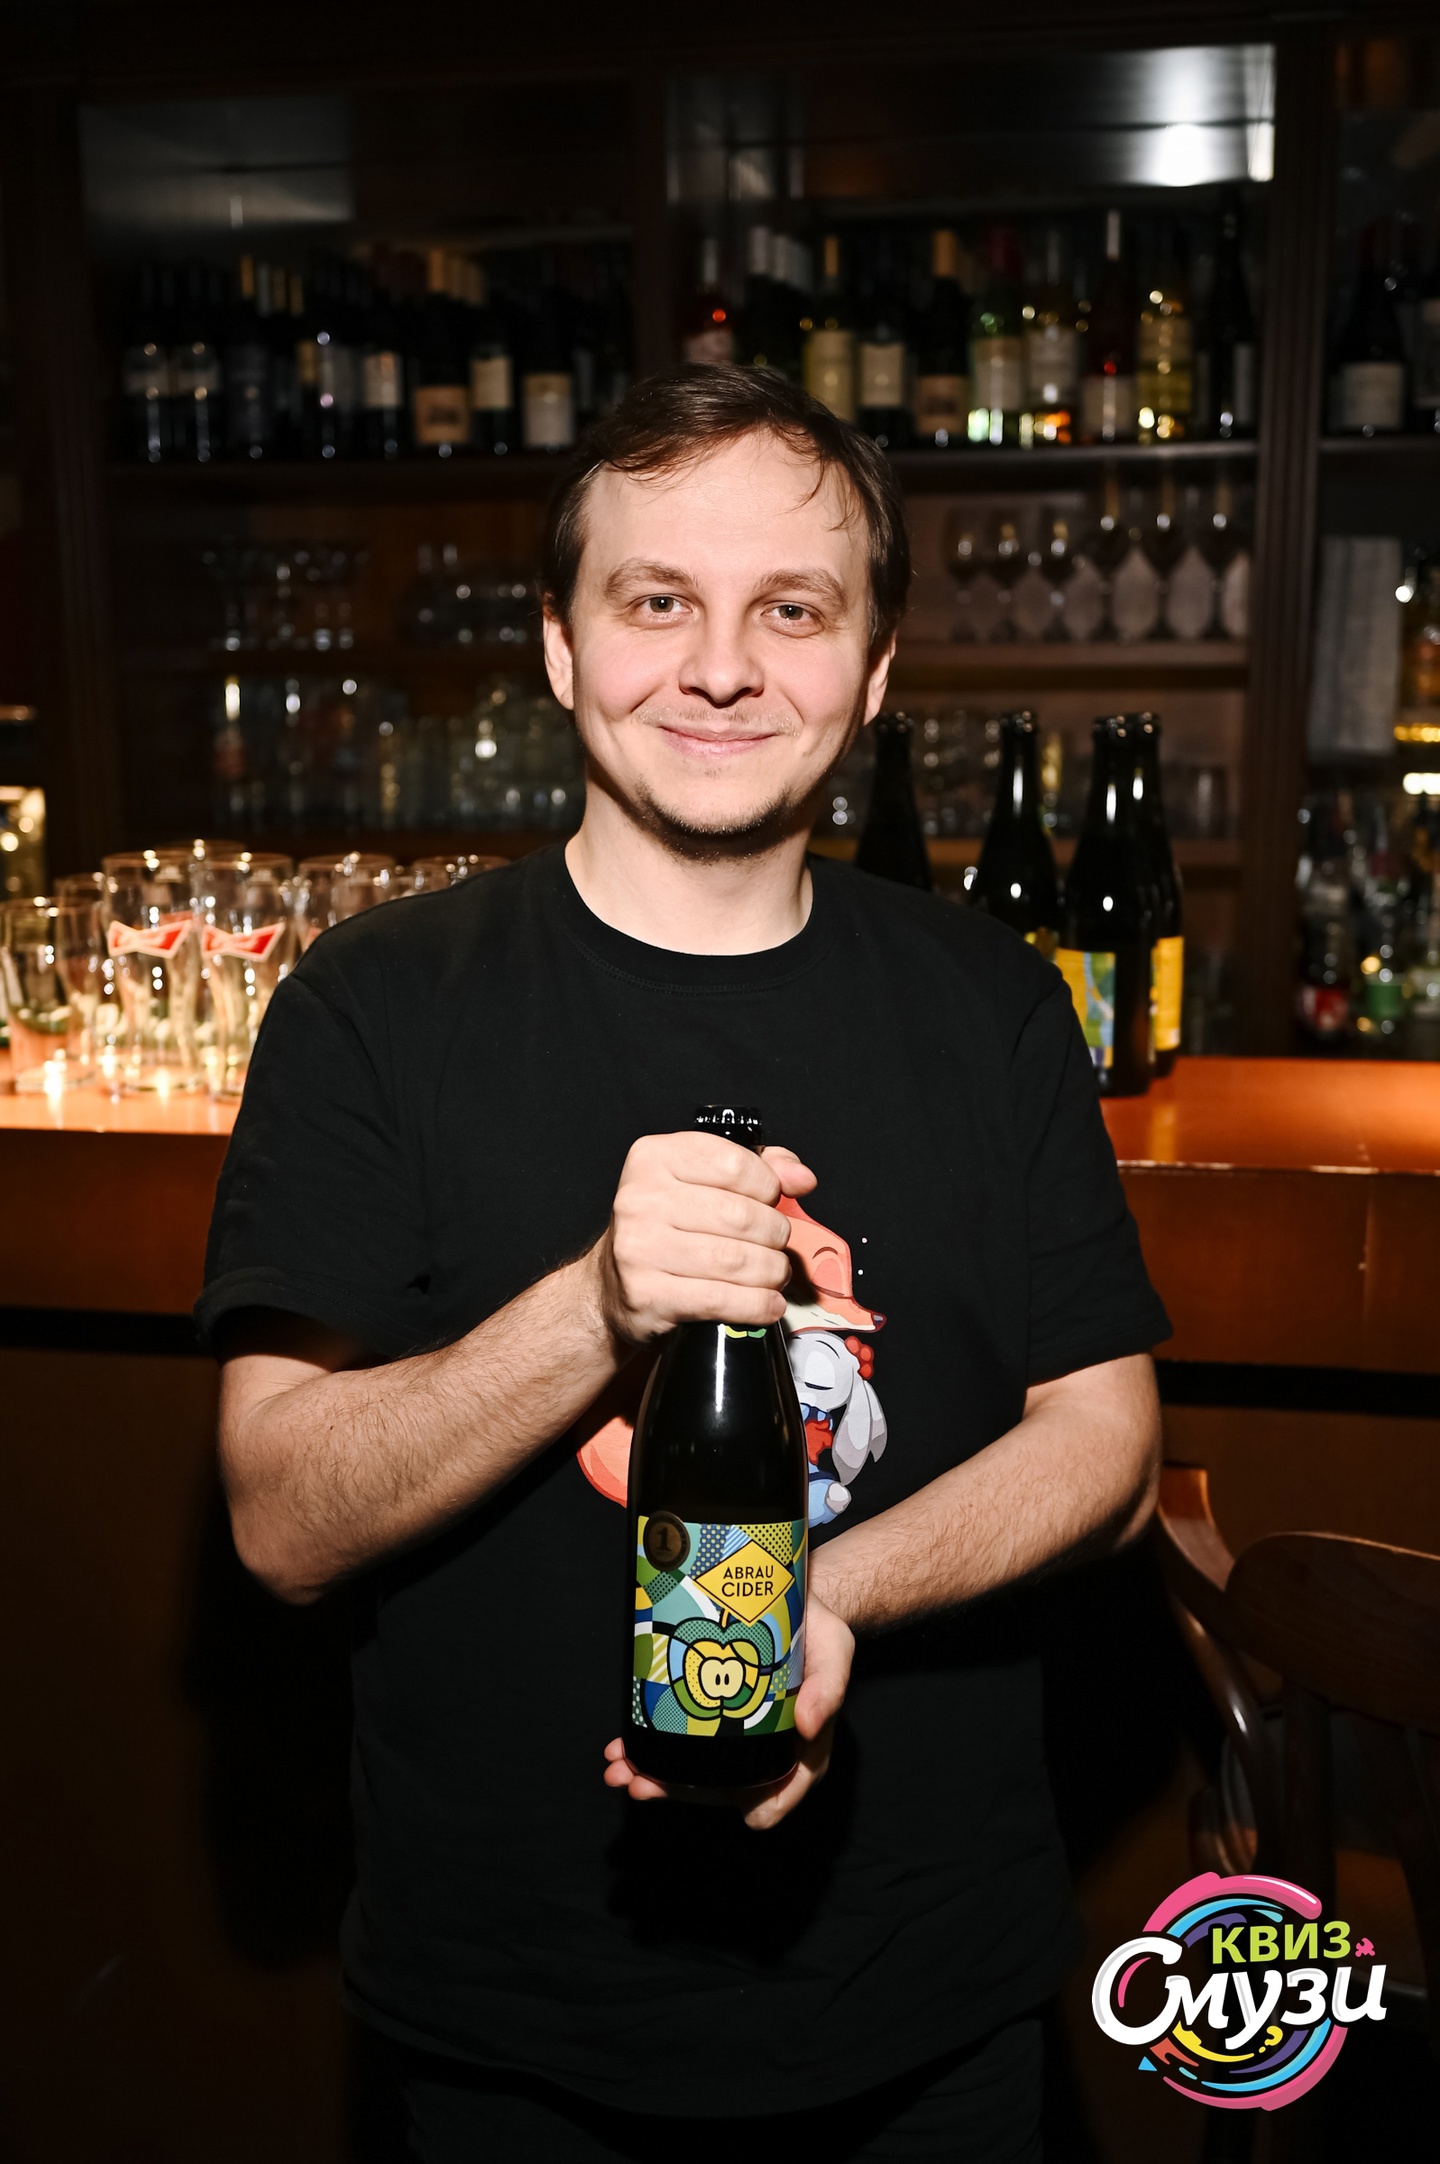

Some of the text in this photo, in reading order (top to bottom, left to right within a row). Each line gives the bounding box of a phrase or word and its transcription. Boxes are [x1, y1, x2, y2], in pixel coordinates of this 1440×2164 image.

[656, 1526, 672, 1551] 1
[723, 1565, 774, 1580] ABRAU
[721, 1581, 774, 1597] CIDER
